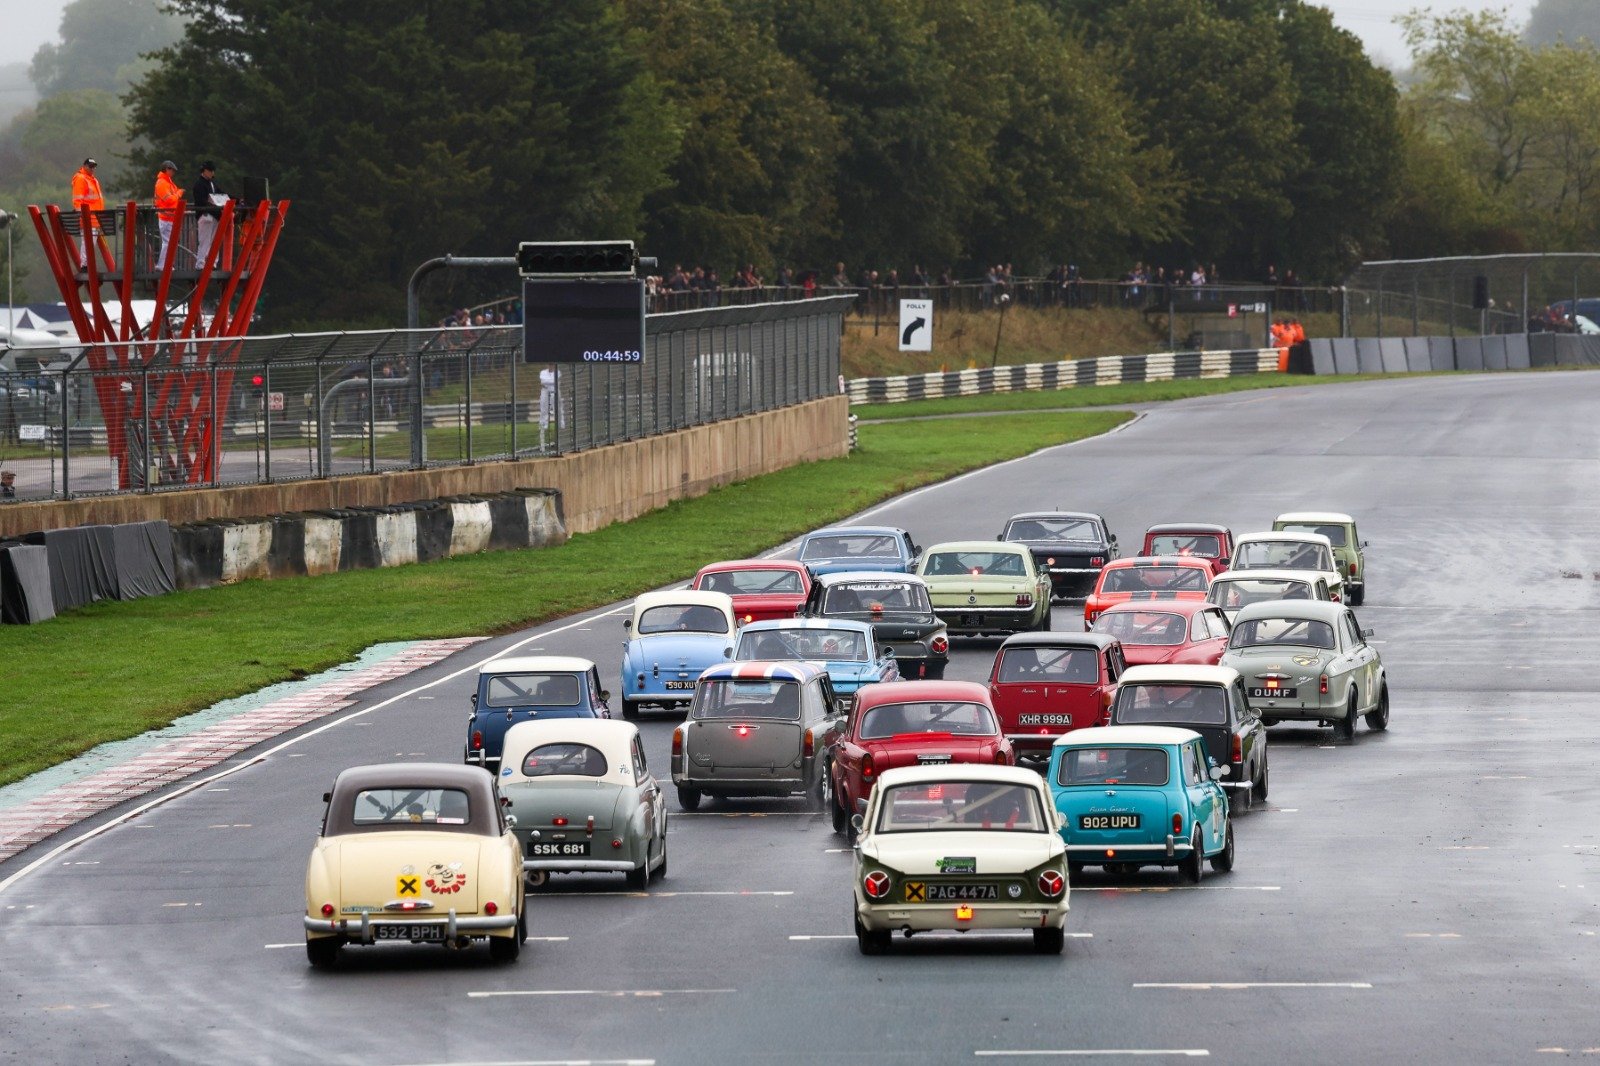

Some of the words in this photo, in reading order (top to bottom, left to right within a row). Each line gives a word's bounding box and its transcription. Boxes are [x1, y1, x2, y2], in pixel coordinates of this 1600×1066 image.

[583, 350, 640, 361] 00:44:59
[668, 681, 683, 689] 590
[1021, 715, 1041, 724] XHR
[1042, 715, 1070, 724] 999A
[1083, 817, 1109, 828] 902
[1111, 816, 1137, 828] UPU
[533, 844, 560, 854] SSK
[563, 844, 585, 854] 681
[425, 873, 466, 895] BUMBLE
[928, 886, 956, 898] PAG
[959, 886, 997, 898] 447A
[379, 926, 408, 939] 532
[411, 926, 440, 939] BPH
